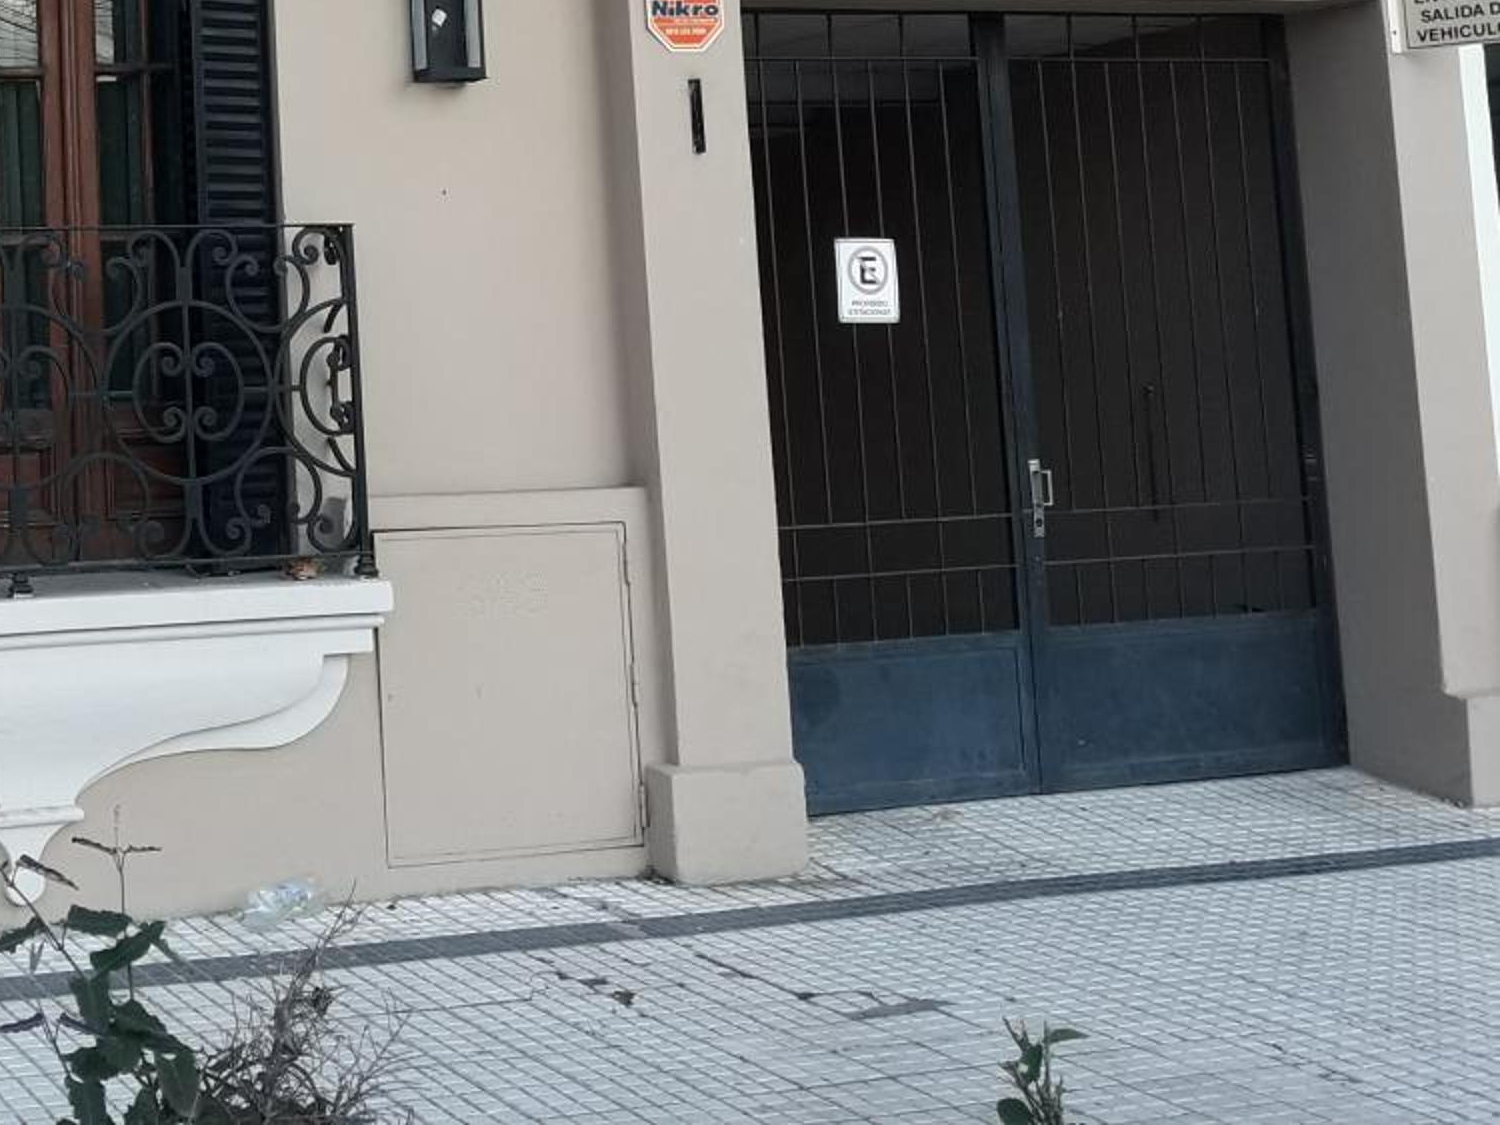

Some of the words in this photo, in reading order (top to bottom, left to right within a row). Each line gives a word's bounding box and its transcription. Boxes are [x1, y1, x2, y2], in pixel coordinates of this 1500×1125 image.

[652, 0, 719, 16] Nikro
[1421, 4, 1485, 24] SALIDA
[1417, 22, 1500, 42] VEHICUL
